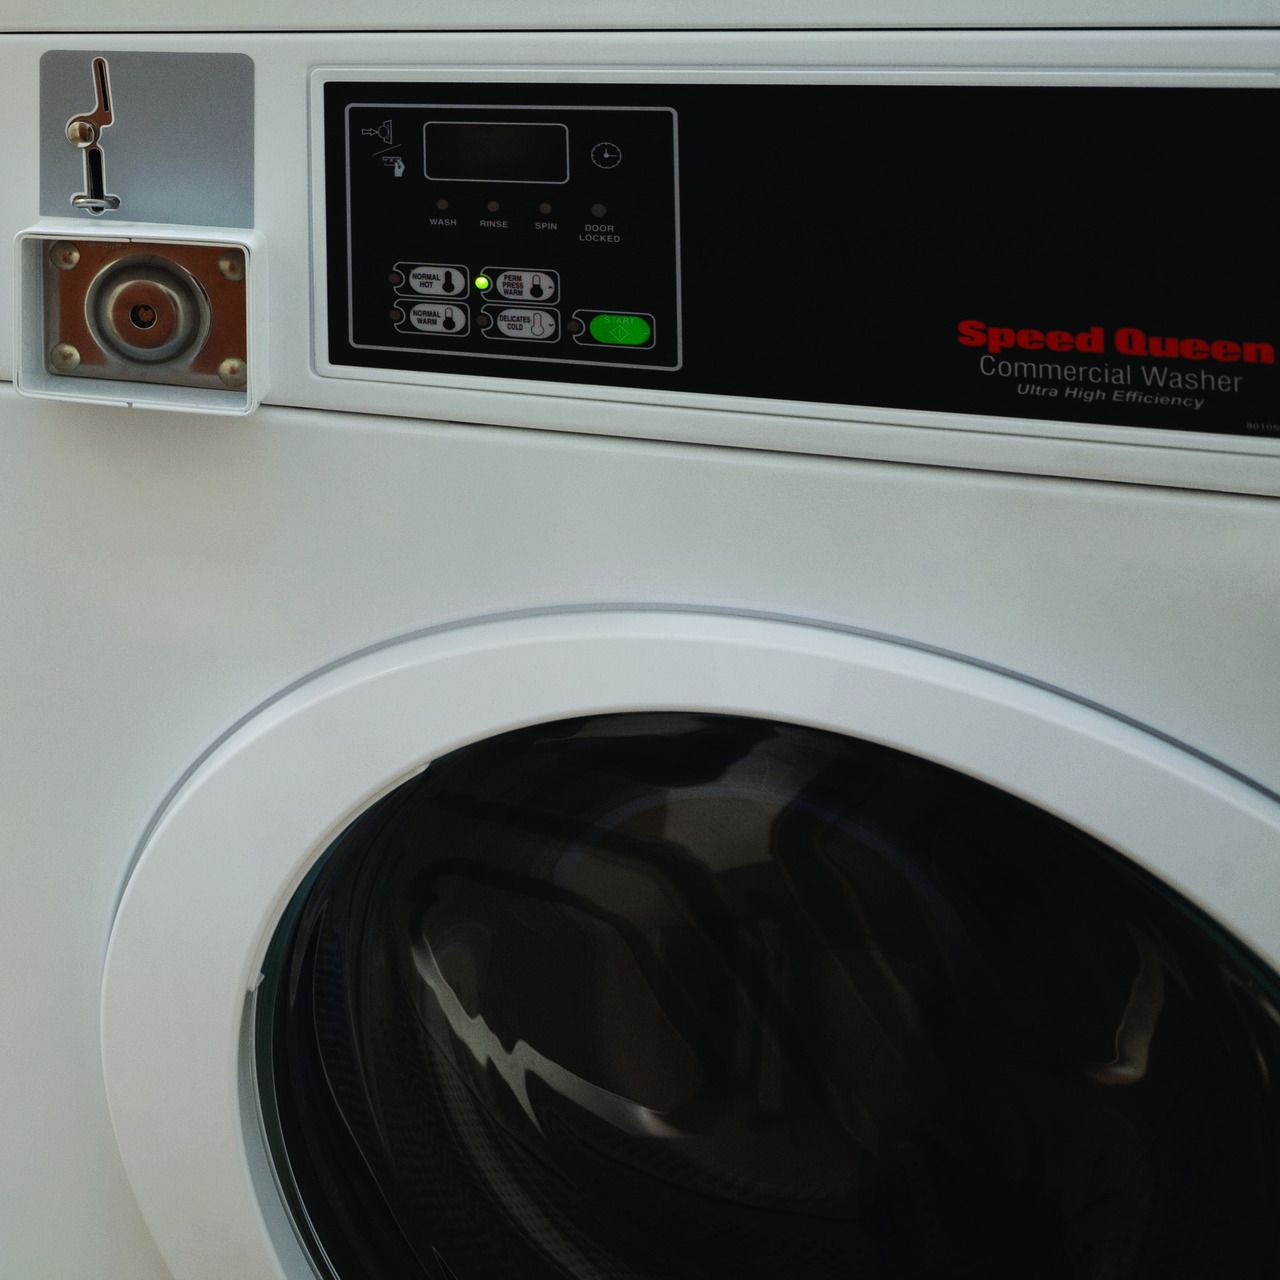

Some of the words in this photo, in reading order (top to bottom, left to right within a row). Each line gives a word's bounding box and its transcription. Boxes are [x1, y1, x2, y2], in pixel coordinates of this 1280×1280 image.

[429, 218, 457, 226] WASH
[480, 220, 509, 229] RINSE
[535, 222, 557, 230] SPIN
[584, 224, 614, 232] DOOR
[579, 234, 620, 243] LOCKED
[412, 273, 440, 281] NORMAL
[413, 310, 441, 318] NORMAL
[499, 315, 530, 323] DELICATES
[605, 316, 635, 324] START
[507, 323, 523, 331] COLD
[957, 319, 1105, 354] Speed
[1115, 327, 1274, 365] Queen
[980, 355, 1132, 386] Commercial
[1141, 365, 1244, 393] Washer
[1017, 383, 1059, 398] Ultra
[1064, 387, 1106, 402] High
[1112, 390, 1205, 411] Efficiency
